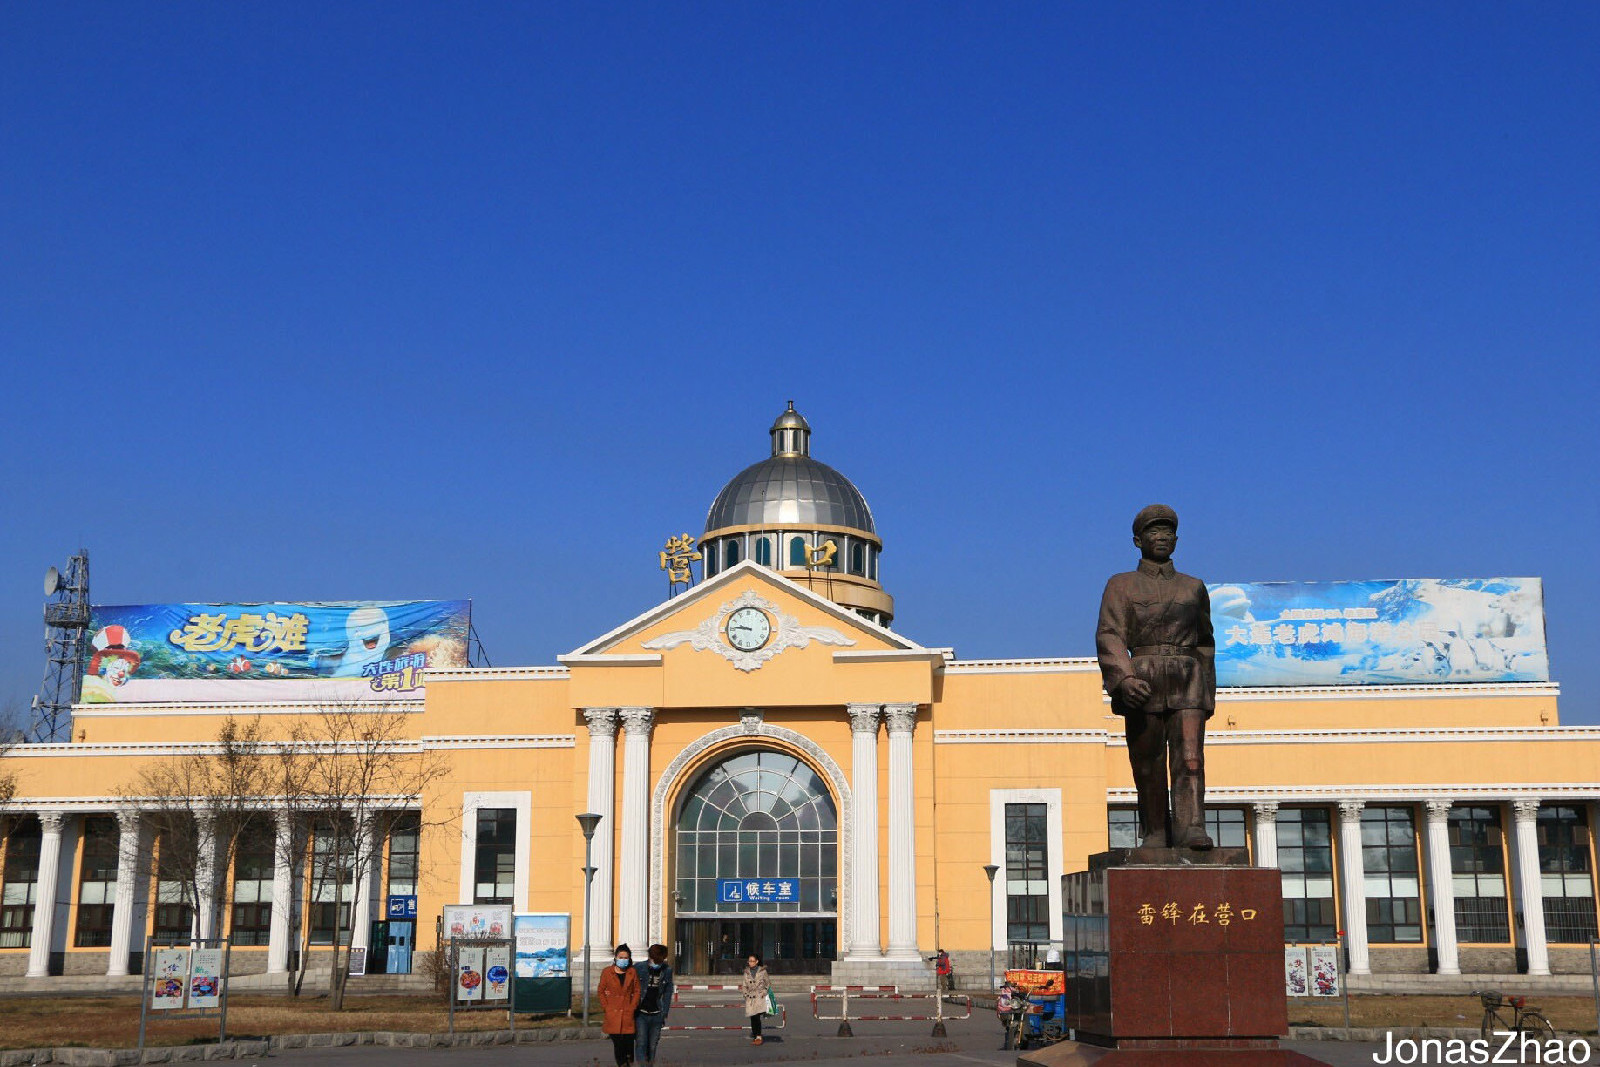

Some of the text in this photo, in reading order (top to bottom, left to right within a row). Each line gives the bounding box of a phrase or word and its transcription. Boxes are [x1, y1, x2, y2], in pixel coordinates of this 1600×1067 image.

[659, 533, 838, 584] 营 口
[170, 612, 309, 652] 老虎滩
[362, 653, 425, 677] 大连旅游
[746, 881, 792, 896] 候车室
[1137, 902, 1257, 926] 雷锋在营口
